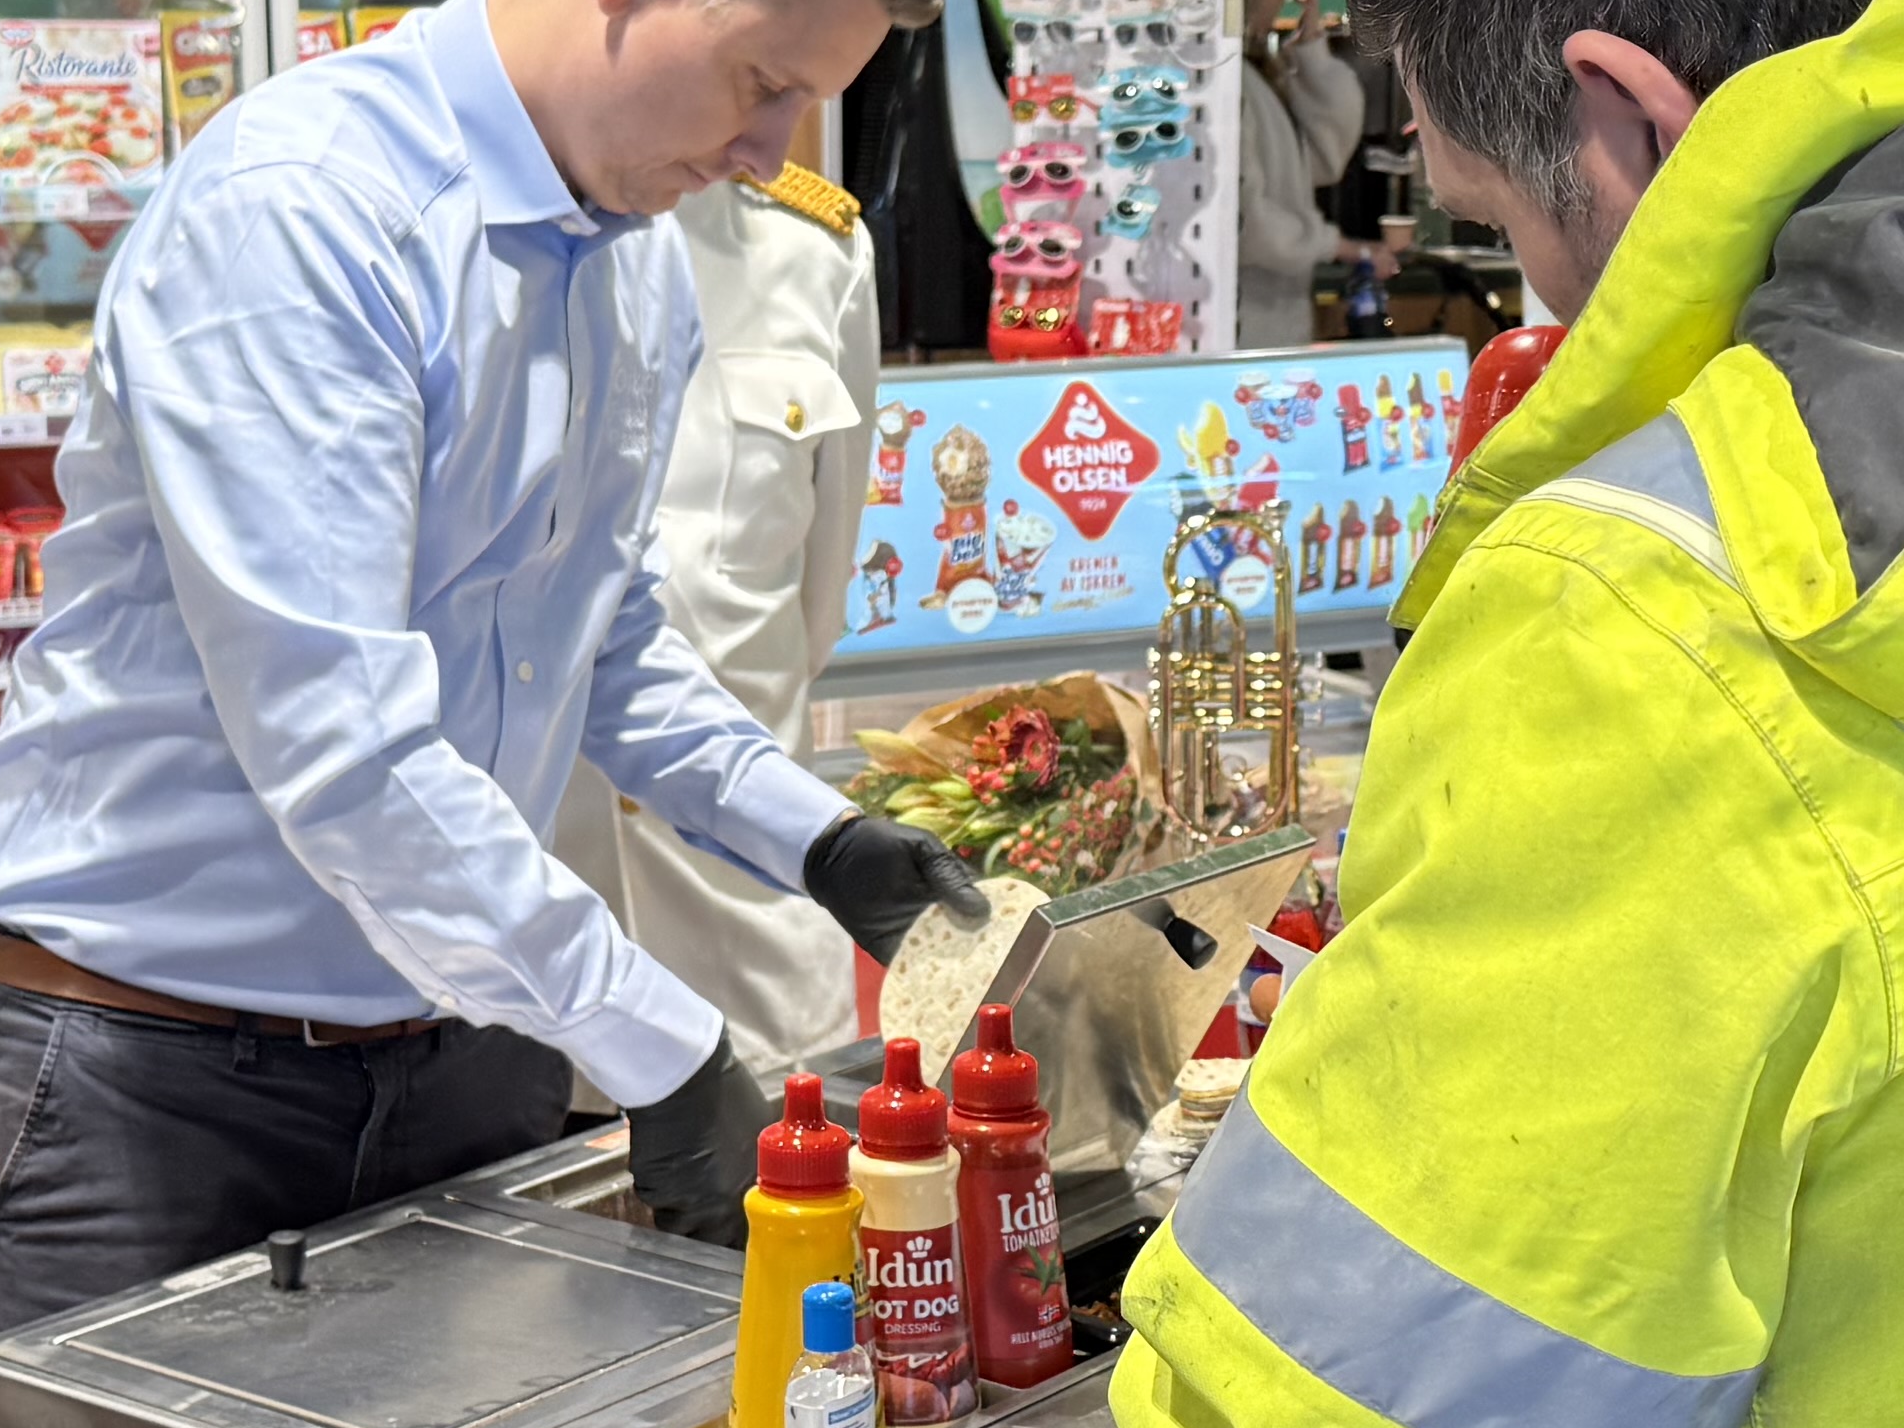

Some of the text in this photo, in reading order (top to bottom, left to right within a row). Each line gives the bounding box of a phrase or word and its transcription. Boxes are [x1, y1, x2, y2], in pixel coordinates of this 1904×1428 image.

[12, 42, 138, 86] Ristorante
[1043, 440, 1134, 469] HENNIG
[1052, 468, 1129, 494] OLSEN
[867, 1247, 954, 1289] Idun
[870, 1294, 960, 1321] OT DOG
[884, 1320, 942, 1335] DRESSING
